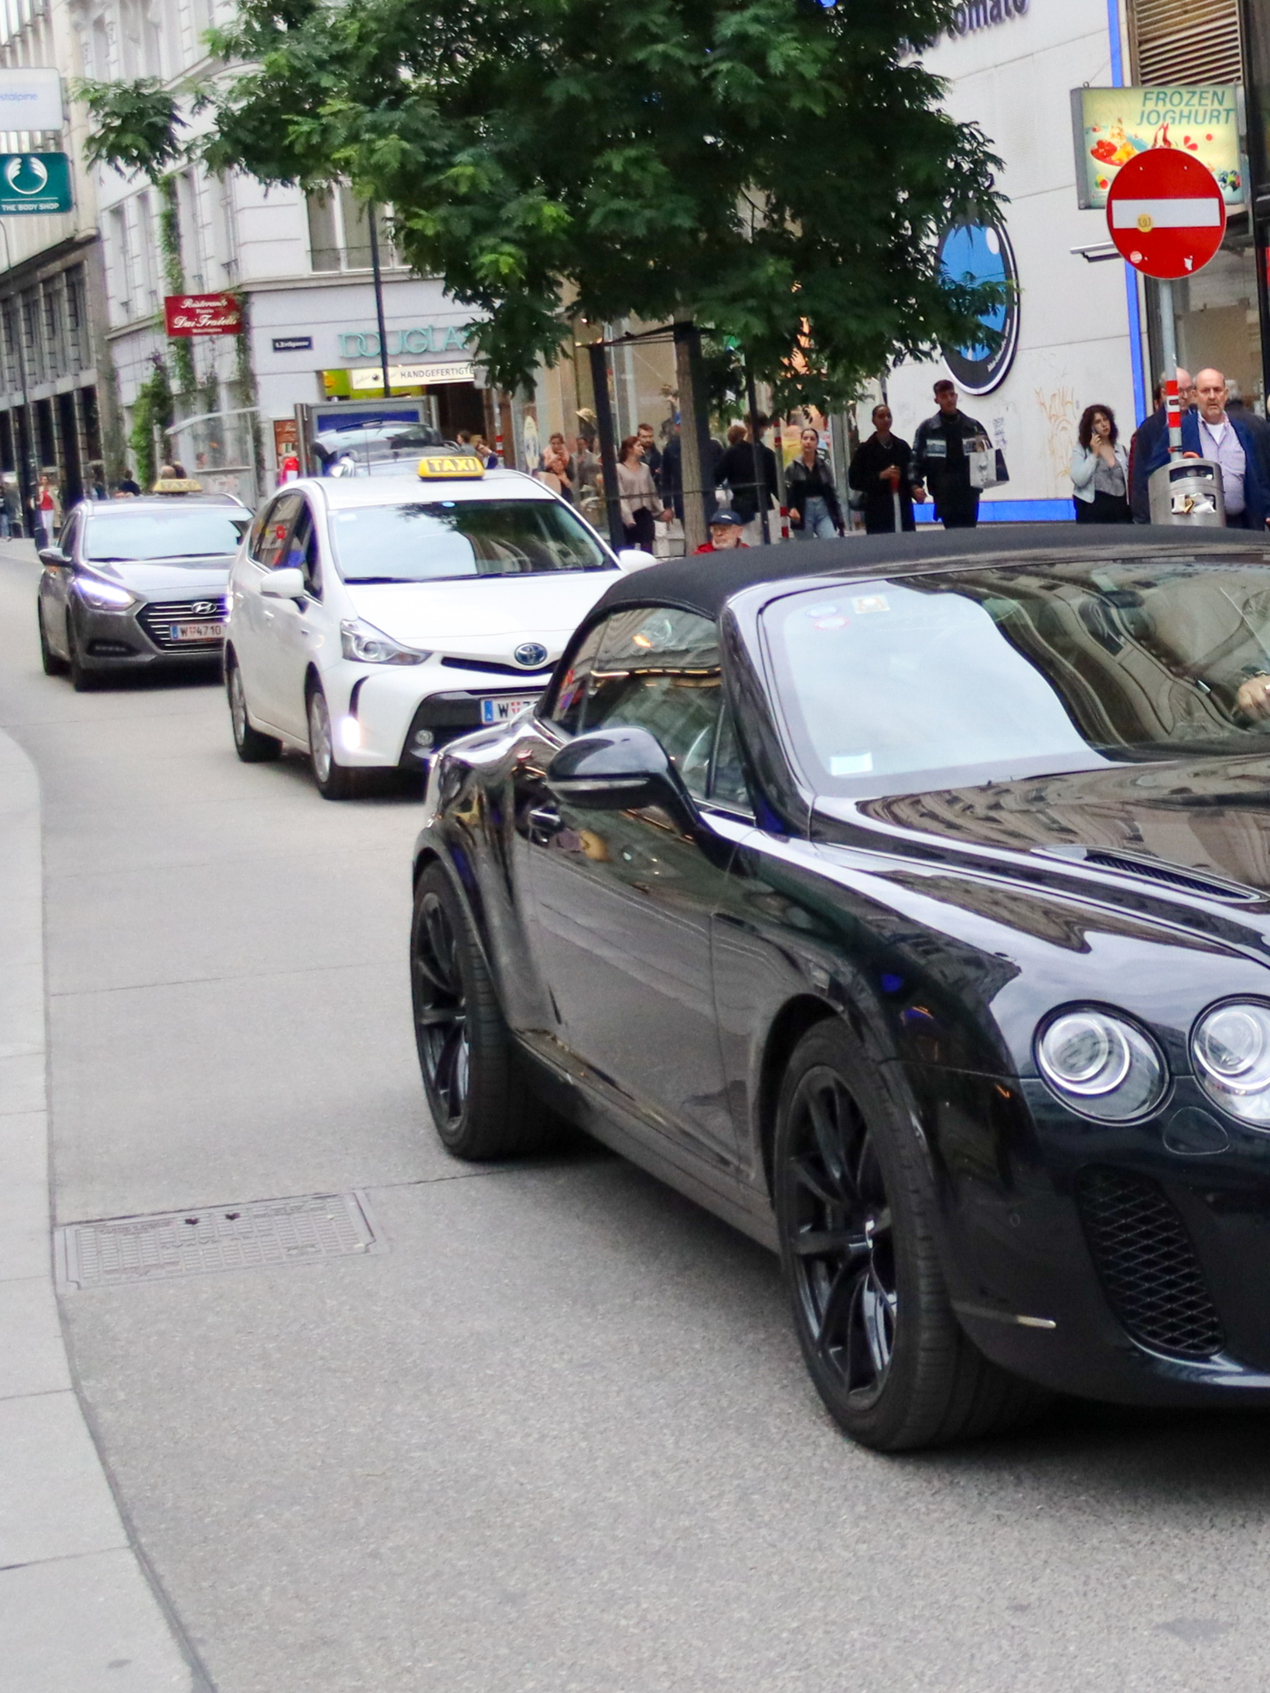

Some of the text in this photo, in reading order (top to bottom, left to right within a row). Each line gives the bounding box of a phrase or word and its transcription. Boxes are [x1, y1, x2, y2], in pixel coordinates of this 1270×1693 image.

[1142, 90, 1226, 108] FROZEN
[1136, 108, 1236, 127] JOGHURT
[18, 203, 38, 211] BODY
[39, 202, 60, 211] SHOP
[173, 315, 196, 329] Dai
[429, 459, 476, 471] TAXI
[161, 481, 195, 490] TAXI
[497, 702, 509, 719] W
